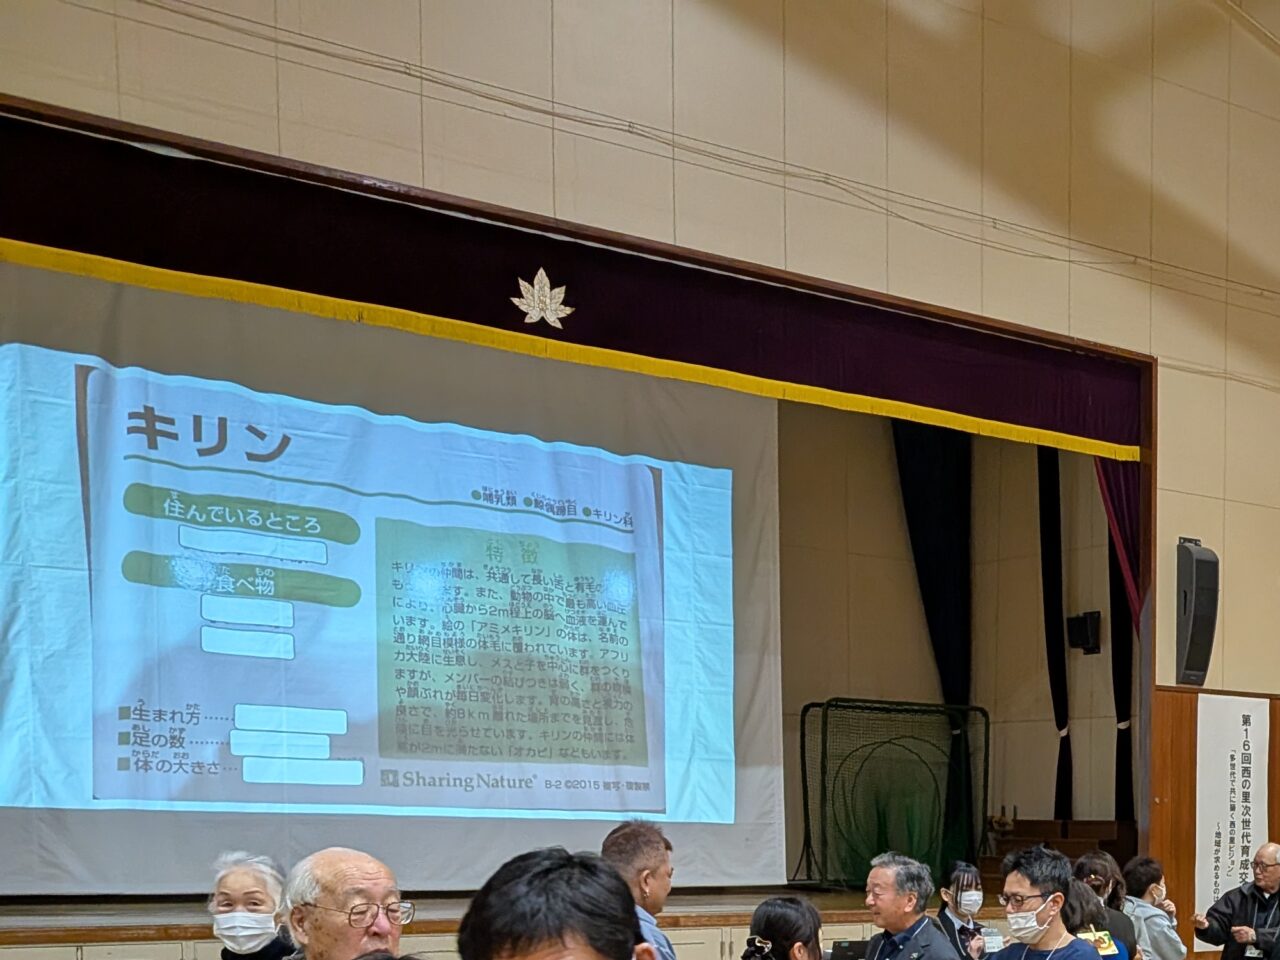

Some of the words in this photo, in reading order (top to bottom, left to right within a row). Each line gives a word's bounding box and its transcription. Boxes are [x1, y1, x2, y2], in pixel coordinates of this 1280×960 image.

[126, 404, 292, 463] キリン
[162, 496, 322, 534] 住んでいるところ
[215, 573, 275, 596] 食べ物
[131, 706, 201, 726] 生まれ方
[131, 731, 187, 750] 足の数
[133, 756, 221, 776] 体の大きさ
[402, 771, 475, 792] Sharing
